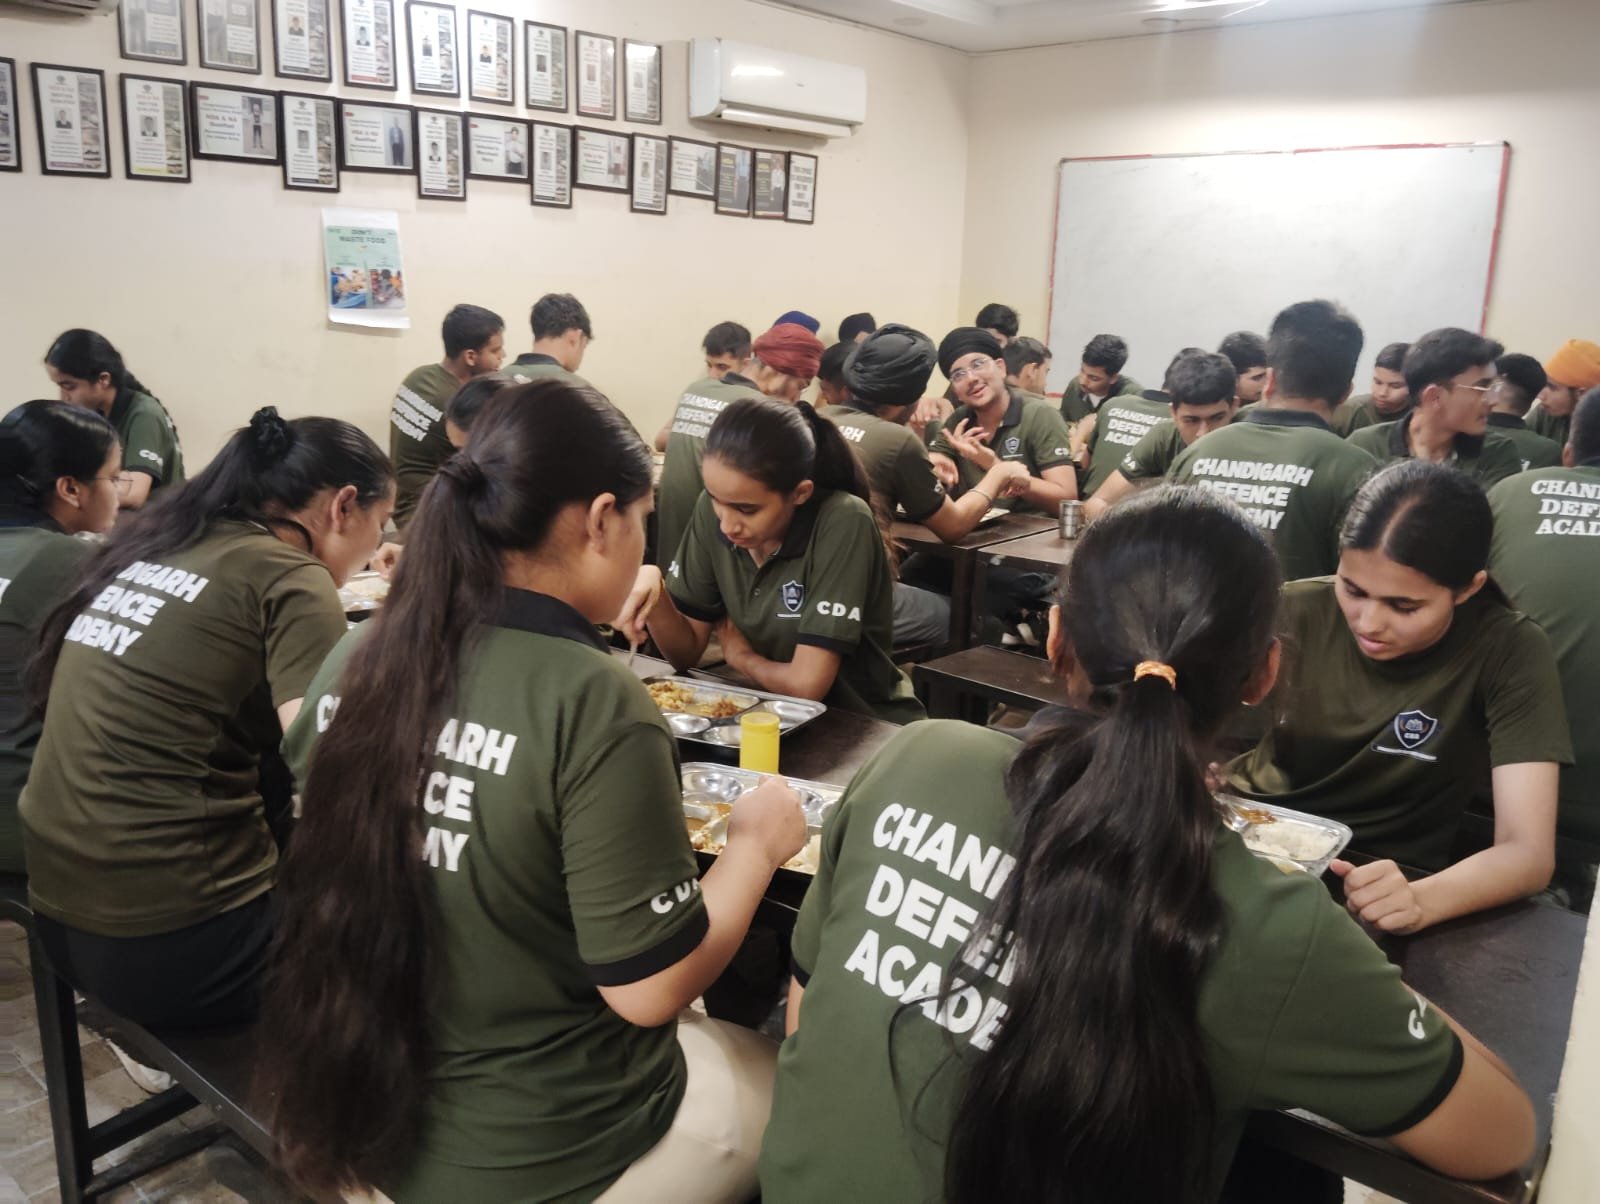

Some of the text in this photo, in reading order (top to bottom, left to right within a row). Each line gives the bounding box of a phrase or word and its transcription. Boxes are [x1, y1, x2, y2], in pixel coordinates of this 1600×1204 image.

[1192, 458, 1314, 487] CHANDIGARH
[1538, 498, 1600, 518] DEF
[816, 601, 861, 621] CDA
